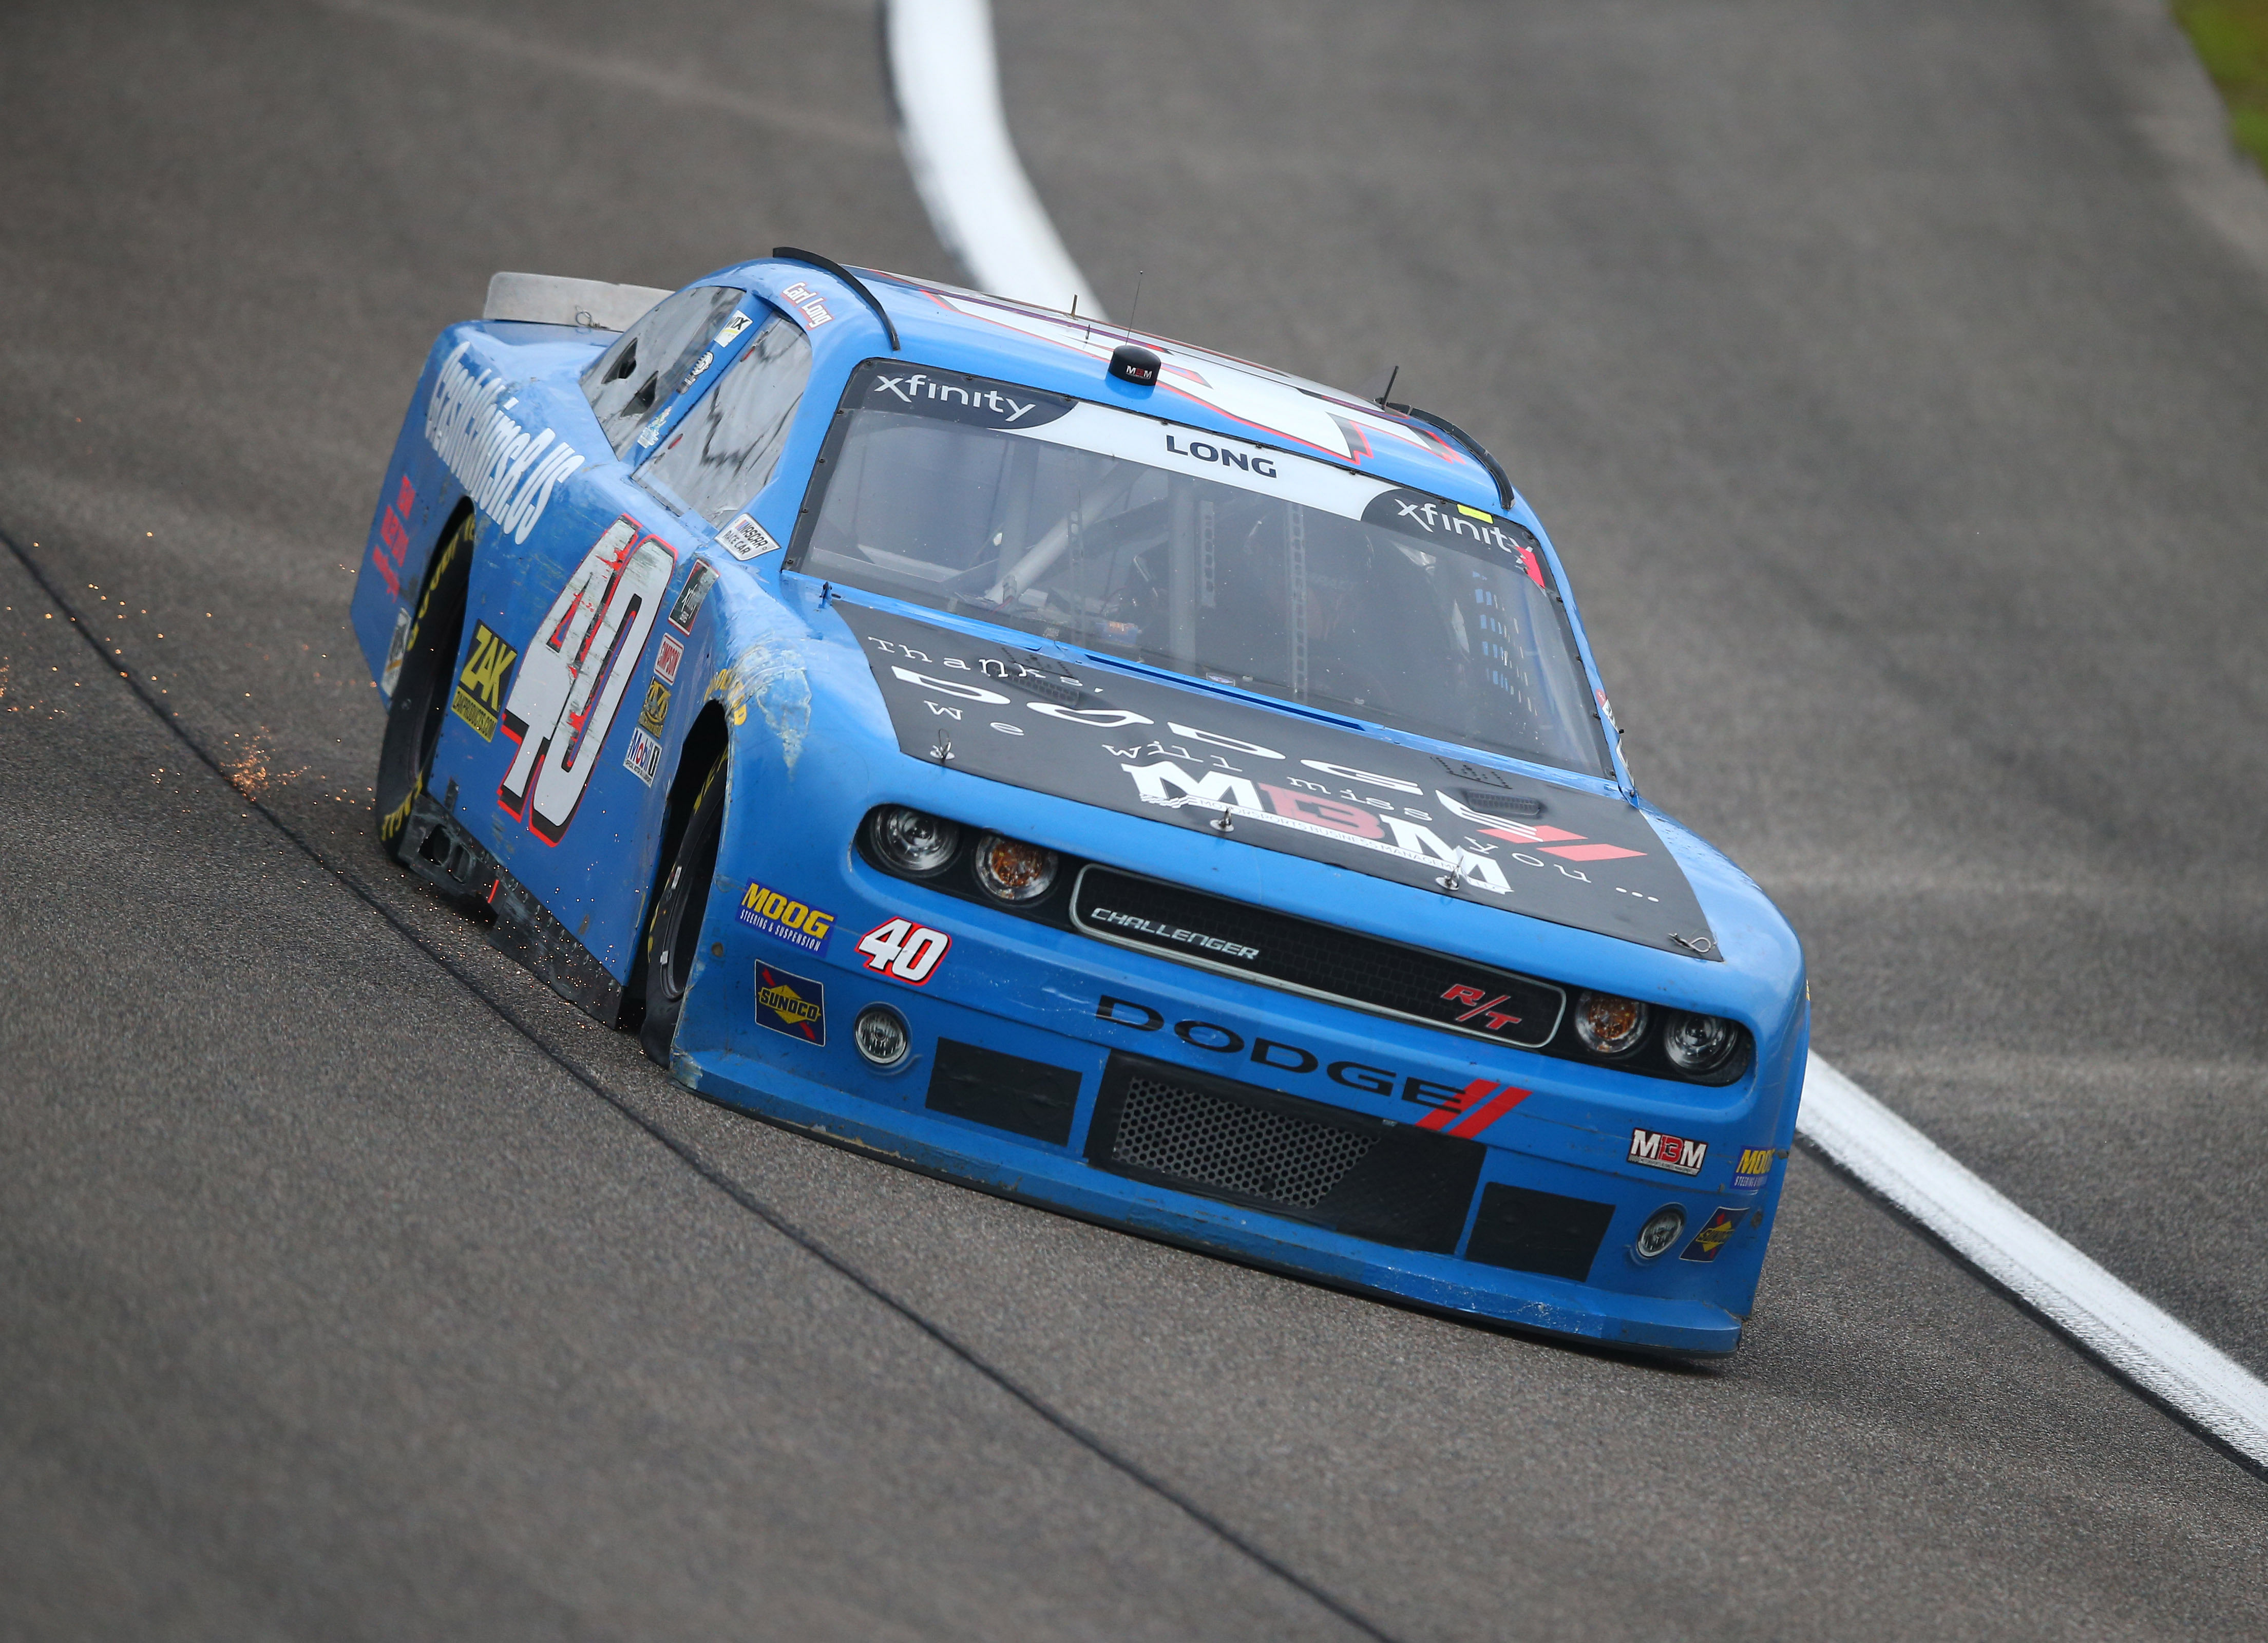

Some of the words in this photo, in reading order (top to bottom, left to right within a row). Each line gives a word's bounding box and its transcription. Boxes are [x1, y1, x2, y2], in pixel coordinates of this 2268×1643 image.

[781, 281, 818, 306] Carl
[800, 297, 833, 329] Long
[1126, 365, 1153, 379] MBM
[874, 374, 1036, 422] xfinity
[1166, 435, 1278, 479] LONG
[722, 528, 736, 544] RACE
[734, 540, 751, 555] CAR
[738, 523, 769, 549] NASCAR
[460, 625, 518, 712] ZAK
[499, 515, 677, 845] 40
[628, 730, 654, 771] Mobil
[891, 666, 1544, 843] DODGE
[1102, 740, 1243, 772] will
[1286, 776, 1433, 821] miss
[1120, 760, 1513, 893] MBM
[1309, 825, 1378, 849] BUSINESS
[740, 909, 768, 930] STEERING
[769, 922, 774, 933] &
[775, 924, 821, 952] SUSPENSION
[741, 882, 834, 939] MOOG
[1091, 907, 1260, 960] CHALLENGER
[856, 917, 950, 985] 40
[760, 989, 817, 1021] SUNOCO
[1442, 984, 1521, 1030] R/T
[1095, 994, 1466, 1115] DODGE
[1630, 1129, 1707, 1169] MBM
